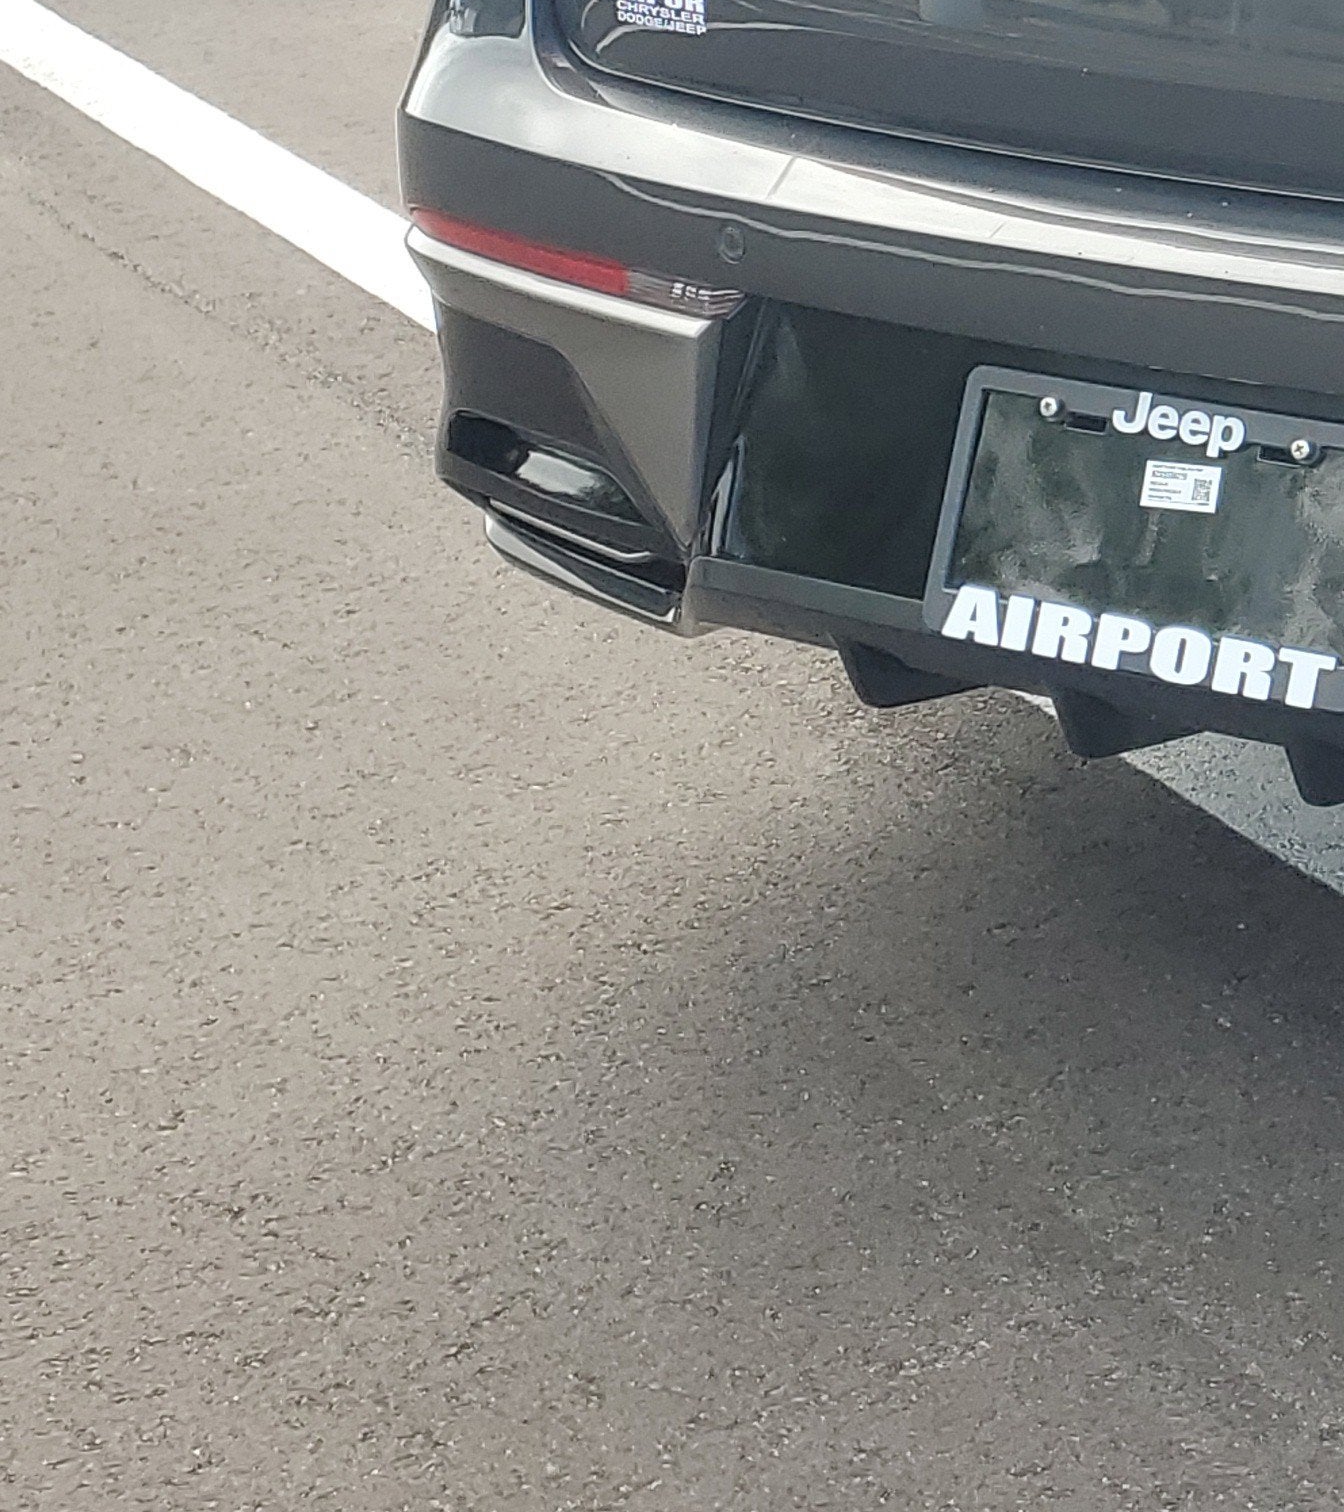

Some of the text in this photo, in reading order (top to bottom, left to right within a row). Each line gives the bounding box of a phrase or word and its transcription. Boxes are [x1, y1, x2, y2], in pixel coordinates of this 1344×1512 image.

[616, 0, 705, 25] CHRYSLER
[1112, 391, 1246, 457] Jeep
[941, 584, 1335, 709] AIRPORT
